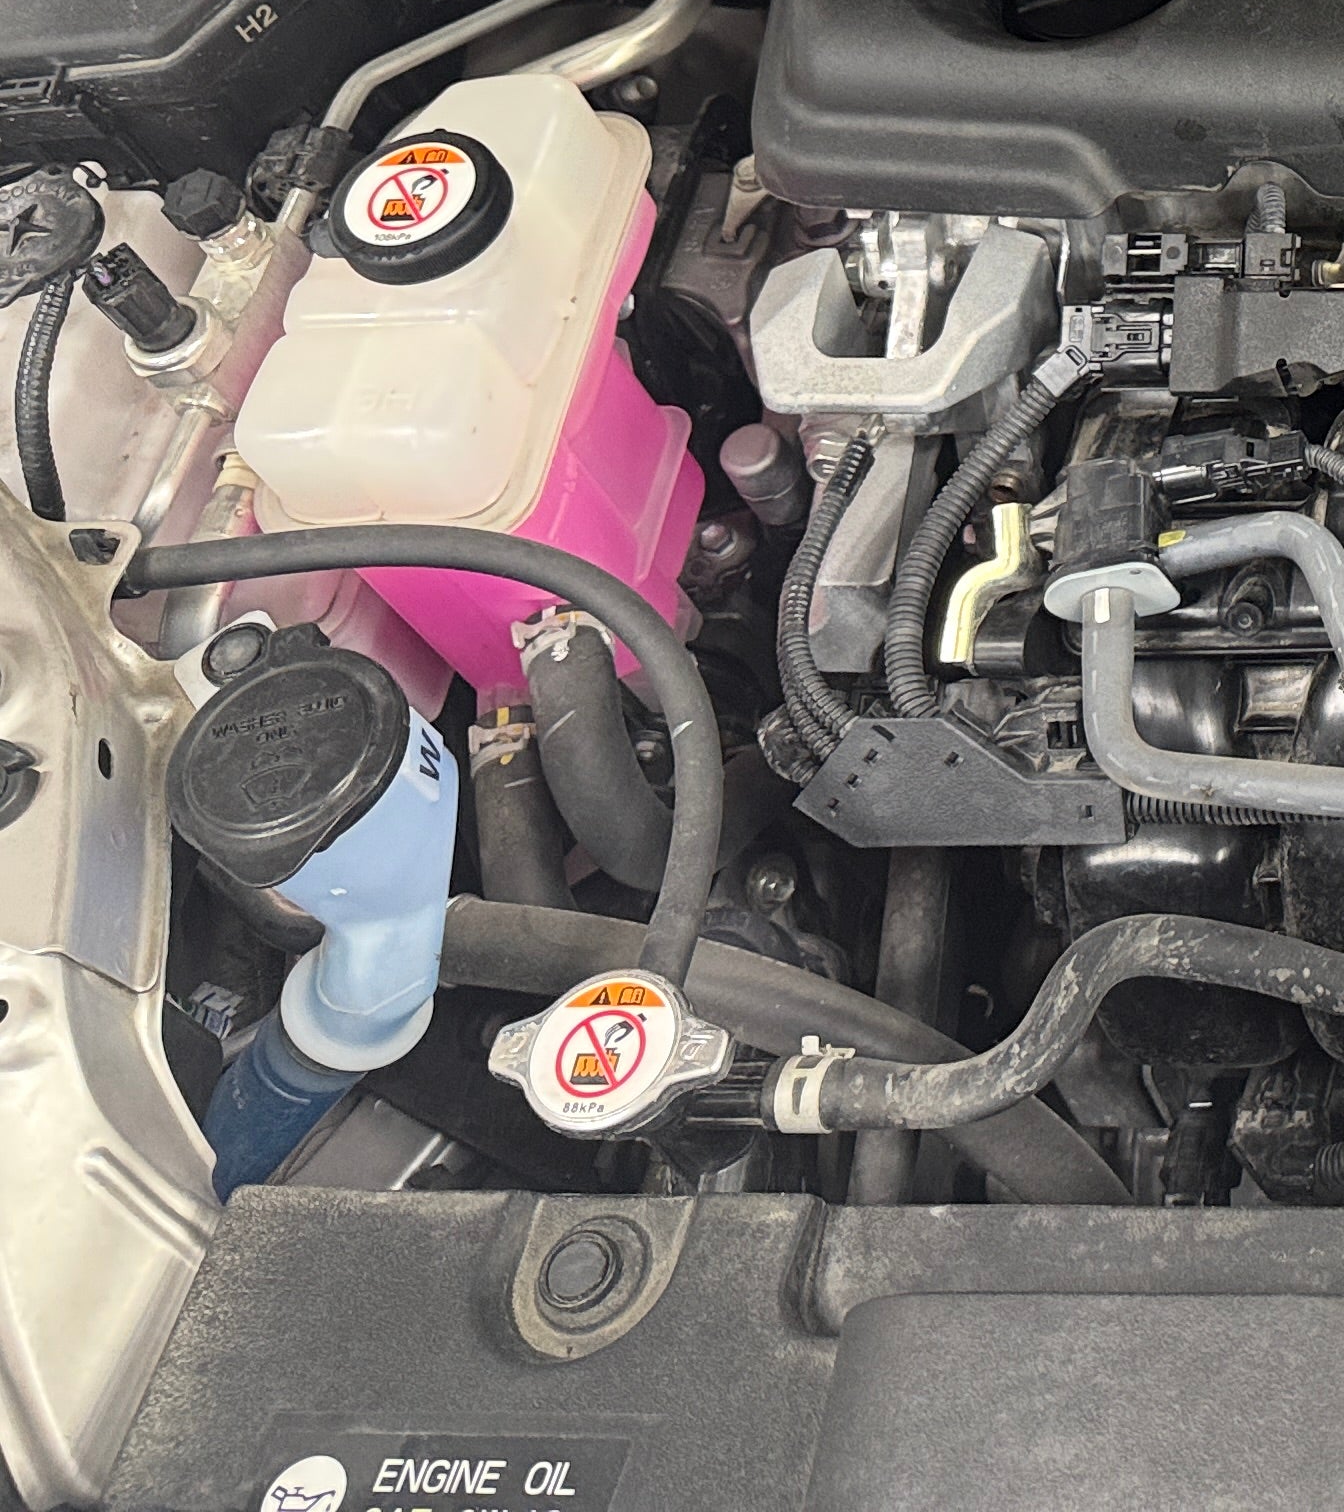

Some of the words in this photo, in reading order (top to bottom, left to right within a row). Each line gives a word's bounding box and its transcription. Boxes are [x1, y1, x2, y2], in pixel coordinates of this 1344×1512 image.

[234, 3, 279, 43] H2
[562, 1102, 604, 1114] 88kPa
[372, 1458, 507, 1495] ENGINE
[523, 1461, 576, 1496] OIL
